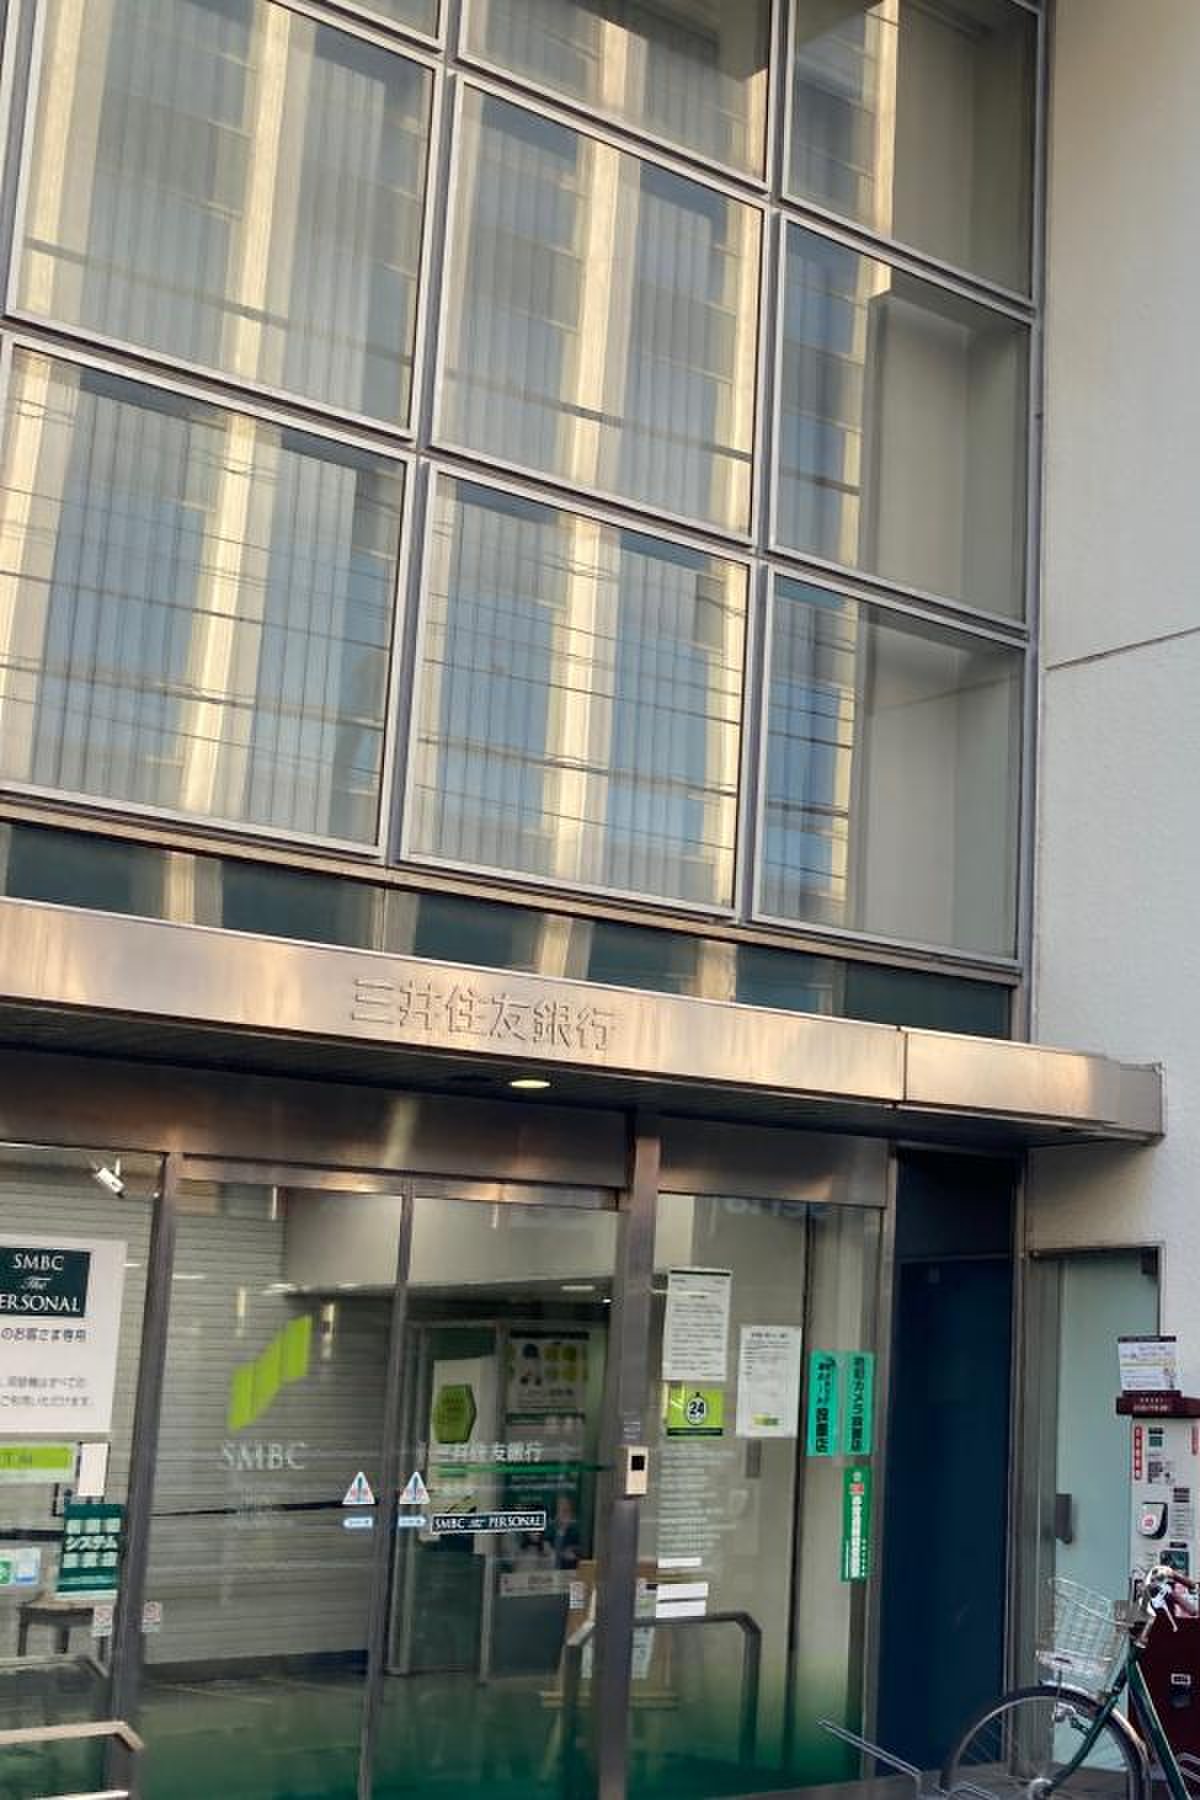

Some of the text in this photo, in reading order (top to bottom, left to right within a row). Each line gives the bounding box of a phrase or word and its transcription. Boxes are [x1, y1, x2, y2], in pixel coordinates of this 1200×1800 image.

[351, 979, 616, 1050] 三井住友銀行
[13, 1253, 65, 1271] SMBC
[0, 1294, 81, 1312] ERSONAL
[688, 1401, 705, 1416] 24
[218, 1437, 307, 1471] SMBC
[65, 1535, 119, 1551] システム
